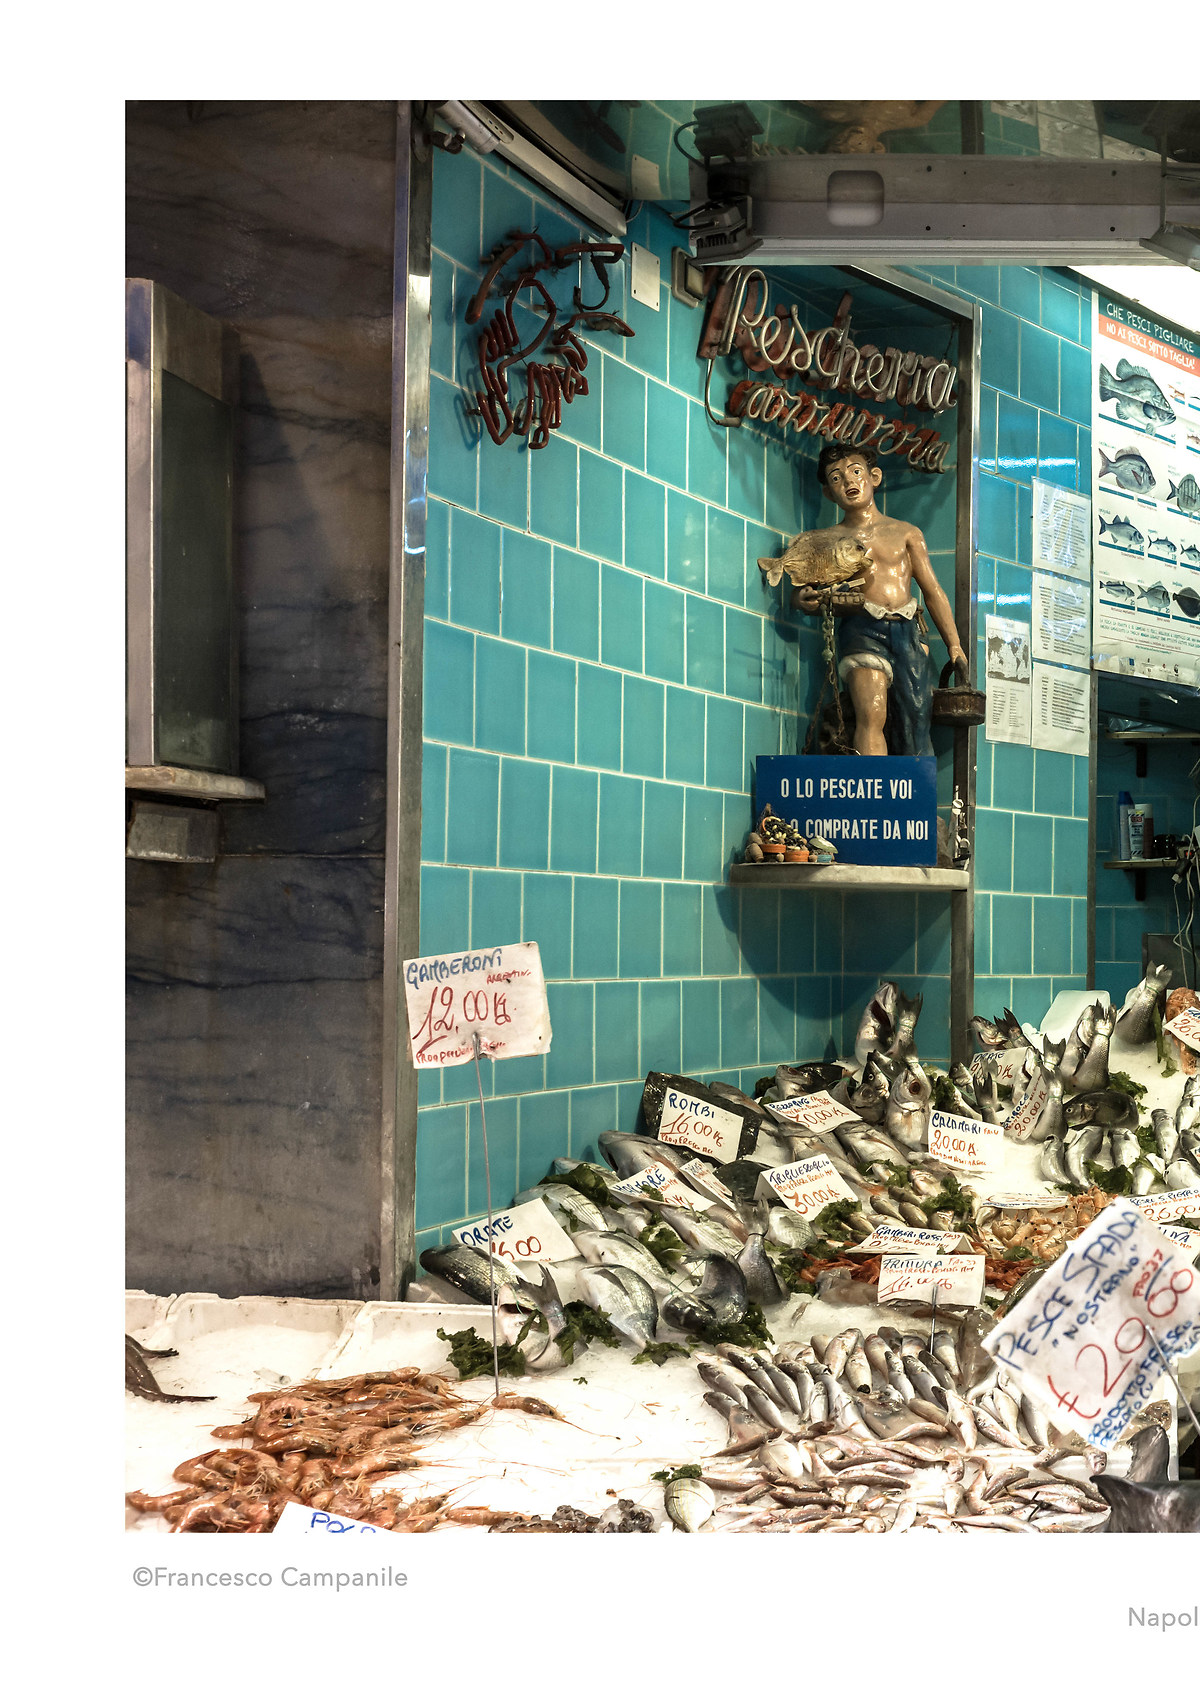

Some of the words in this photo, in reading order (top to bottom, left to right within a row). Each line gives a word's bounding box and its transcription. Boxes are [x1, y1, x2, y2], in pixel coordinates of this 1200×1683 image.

[1106, 303, 1123, 321] CHE
[1127, 311, 1151, 333] PESCI
[1154, 324, 1195, 353] PIGLIARE
[1106, 322, 1117, 335] NO
[1118, 327, 1126, 338] AI
[1127, 329, 1147, 348] PESCI
[1148, 340, 1168, 358] SOTTO
[1169, 349, 1196, 370] TAGLIA!
[781, 778, 790, 798] O
[796, 778, 814, 798] LO
[820, 778, 883, 799] PESCATE
[889, 779, 912, 800] VOI
[805, 818, 878, 840] COMPRATE
[883, 820, 901, 840] DA
[906, 820, 929, 841] NOI
[406, 948, 502, 990] GAMBERONI
[668, 1092, 715, 1119] ROMBI
[931, 1112, 981, 1135] CALAMARI
[460, 1215, 514, 1247] ORATE
[882, 1257, 943, 1269] FRITTURA
[995, 1286, 1073, 1371] PESCE
[1062, 1210, 1144, 1294] SPADA
